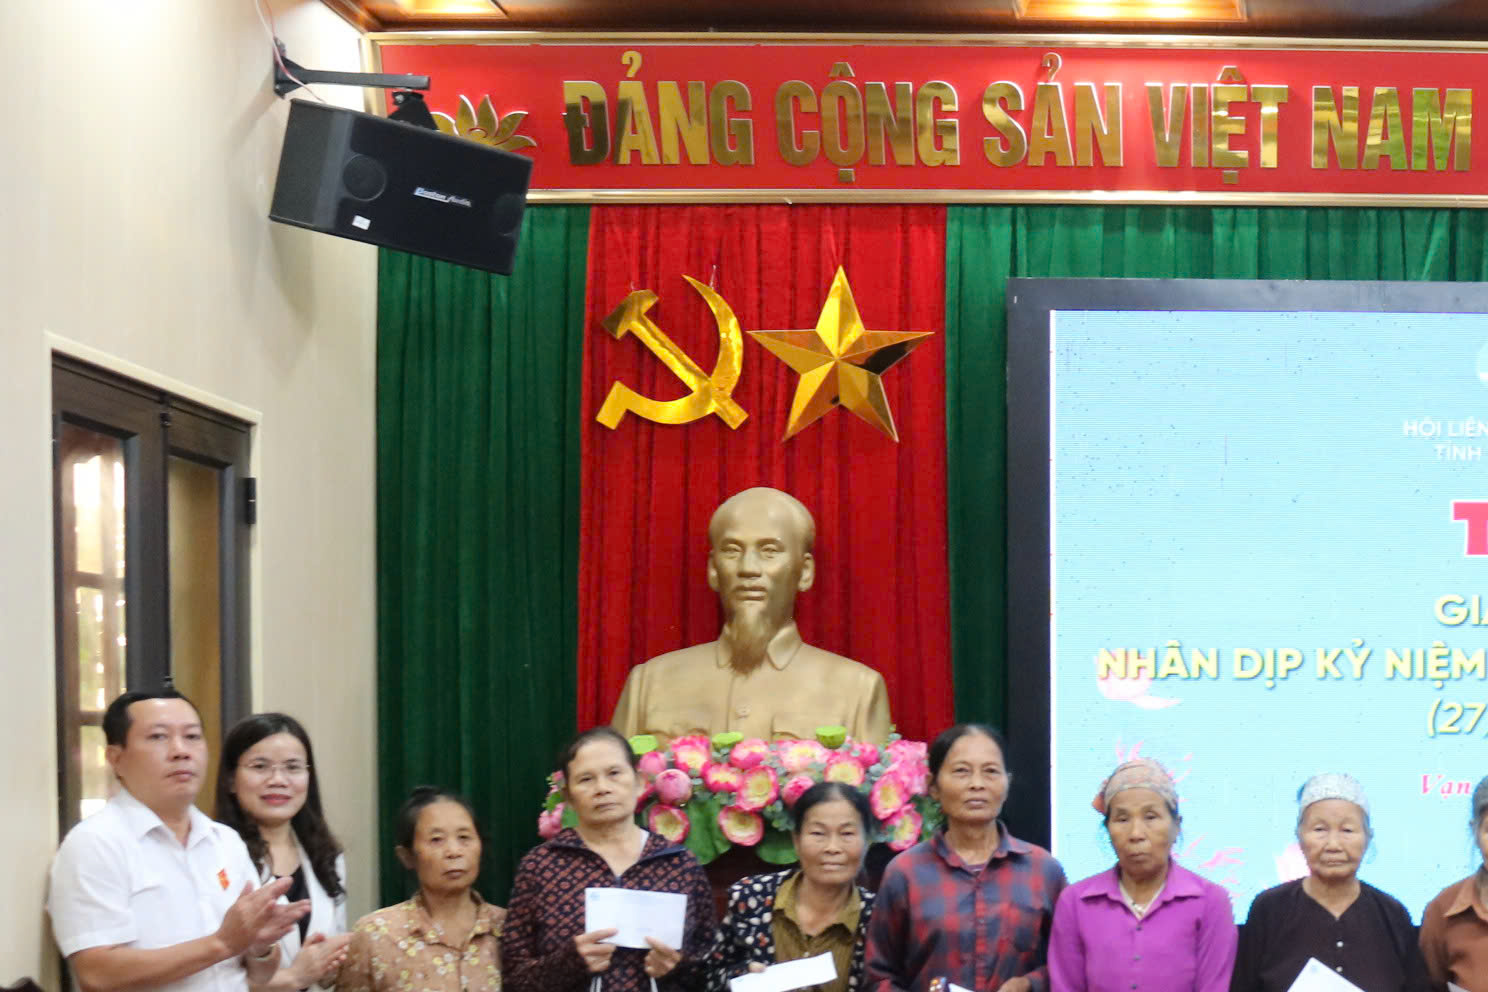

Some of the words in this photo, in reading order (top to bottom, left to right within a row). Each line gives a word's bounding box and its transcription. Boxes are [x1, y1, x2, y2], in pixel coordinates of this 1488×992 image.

[563, 51, 754, 166] ĐẢNG
[775, 62, 960, 182] CỘNG
[982, 52, 1124, 167] SẢN
[1144, 65, 1290, 184] VIỆT
[1311, 86, 1472, 171] NAM
[1098, 639, 1219, 681] NHÂN
[1232, 647, 1304, 690] DỊP
[1315, 638, 1373, 681] KỶ
[1384, 640, 1488, 690] NIỆM
